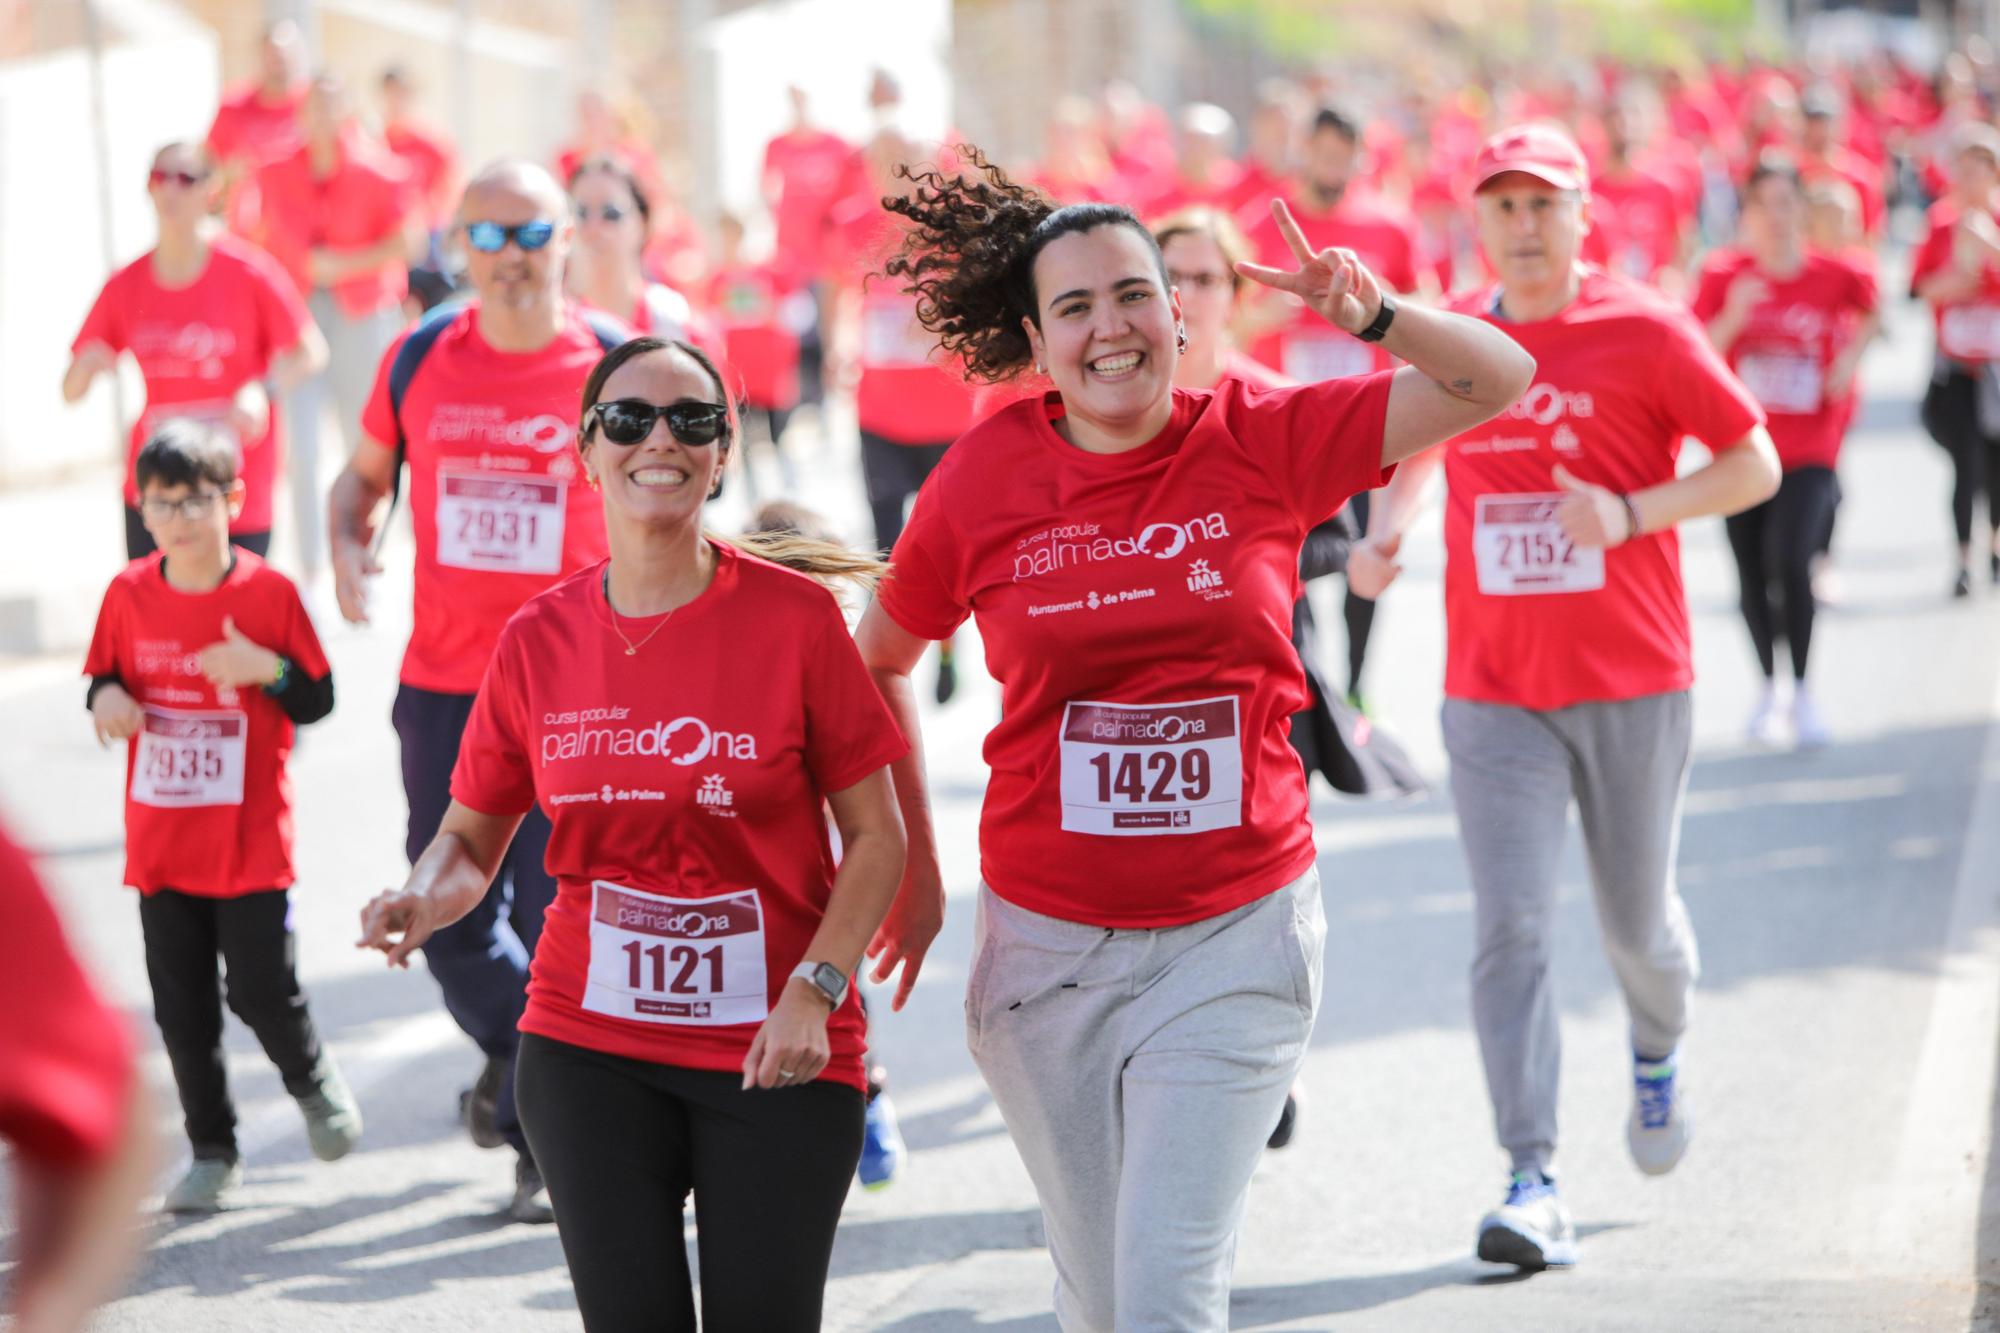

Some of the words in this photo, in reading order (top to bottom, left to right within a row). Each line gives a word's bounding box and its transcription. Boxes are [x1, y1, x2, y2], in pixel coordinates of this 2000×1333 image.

[457, 507, 538, 545] 2931
[1016, 530, 1048, 550] cursa
[1051, 522, 1100, 541] popular
[1496, 531, 1580, 567] 2152
[1186, 570, 1223, 592] IME
[1028, 600, 1084, 617] Ajuntament
[1103, 593, 1118, 605] de
[1119, 587, 1156, 602] Palma
[543, 711, 578, 725] cursa
[580, 706, 631, 726] popular
[1122, 712, 1152, 721] popular
[1089, 747, 1211, 803] 1429
[549, 792, 599, 807] Ajuntament
[615, 789, 630, 801] de
[631, 789, 666, 801] Palma
[696, 788, 734, 806] IME
[621, 940, 724, 994] 1121
